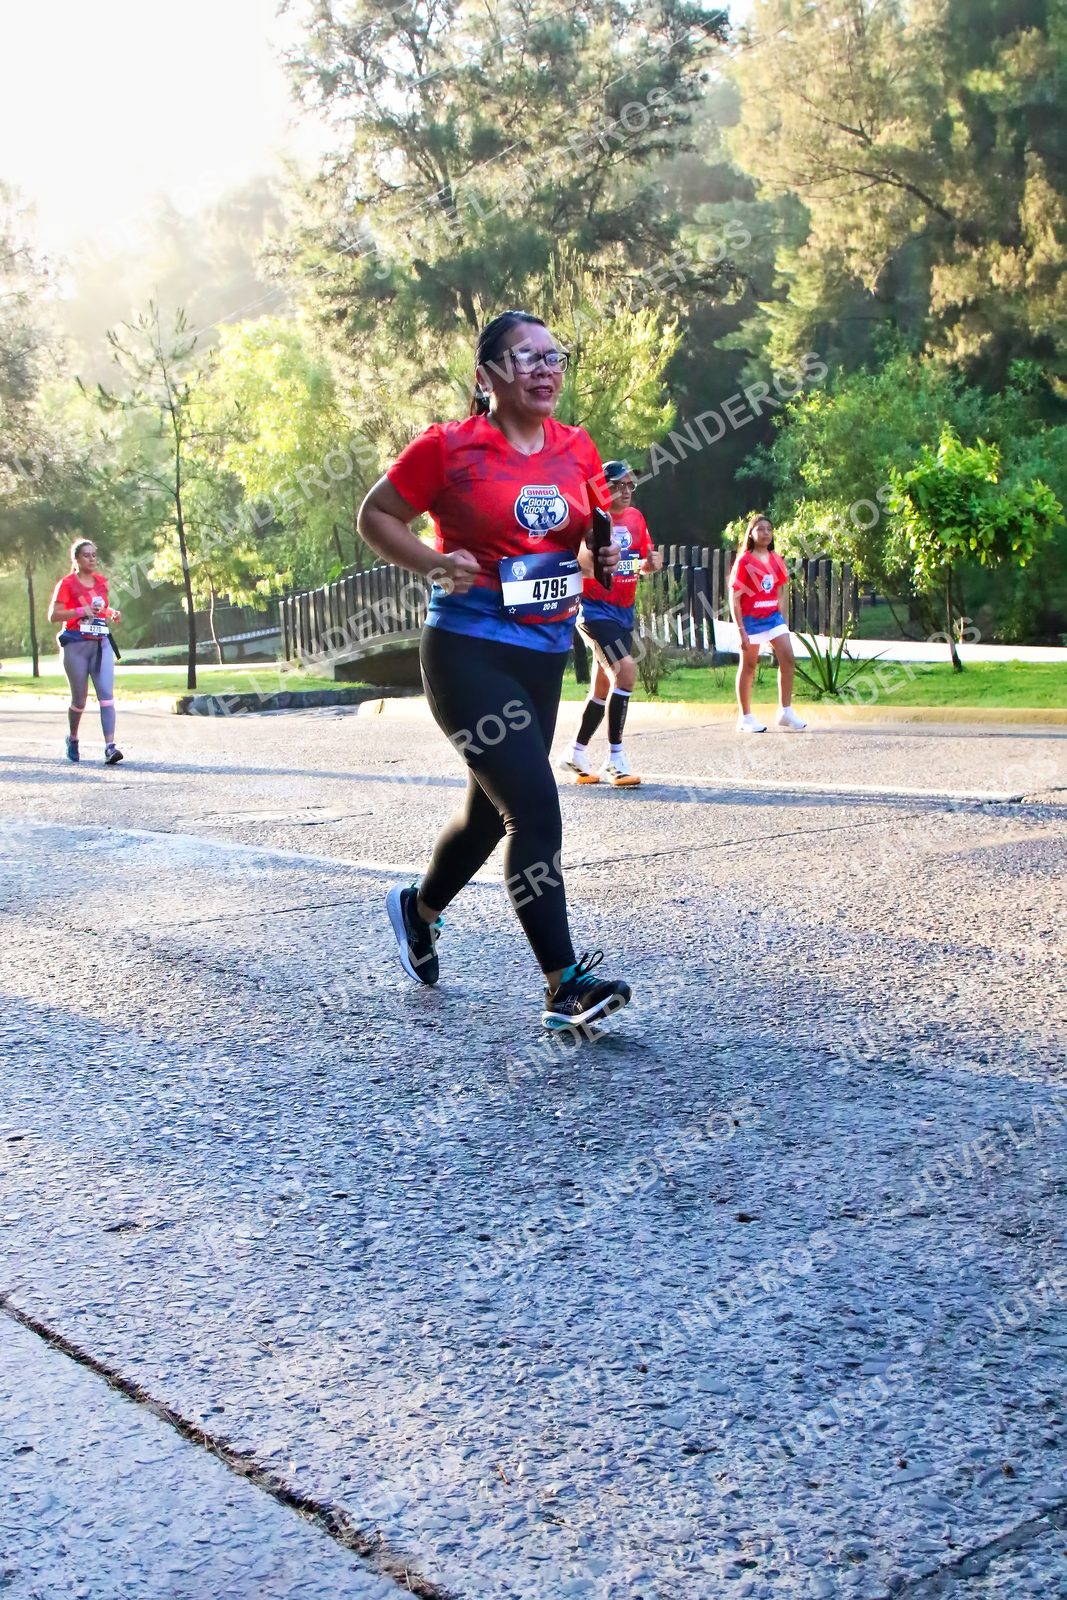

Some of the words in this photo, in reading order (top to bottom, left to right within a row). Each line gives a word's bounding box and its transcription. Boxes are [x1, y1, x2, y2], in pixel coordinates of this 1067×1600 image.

[528, 498, 556, 507] Global
[523, 506, 545, 514] Race
[532, 577, 568, 601] 4795
